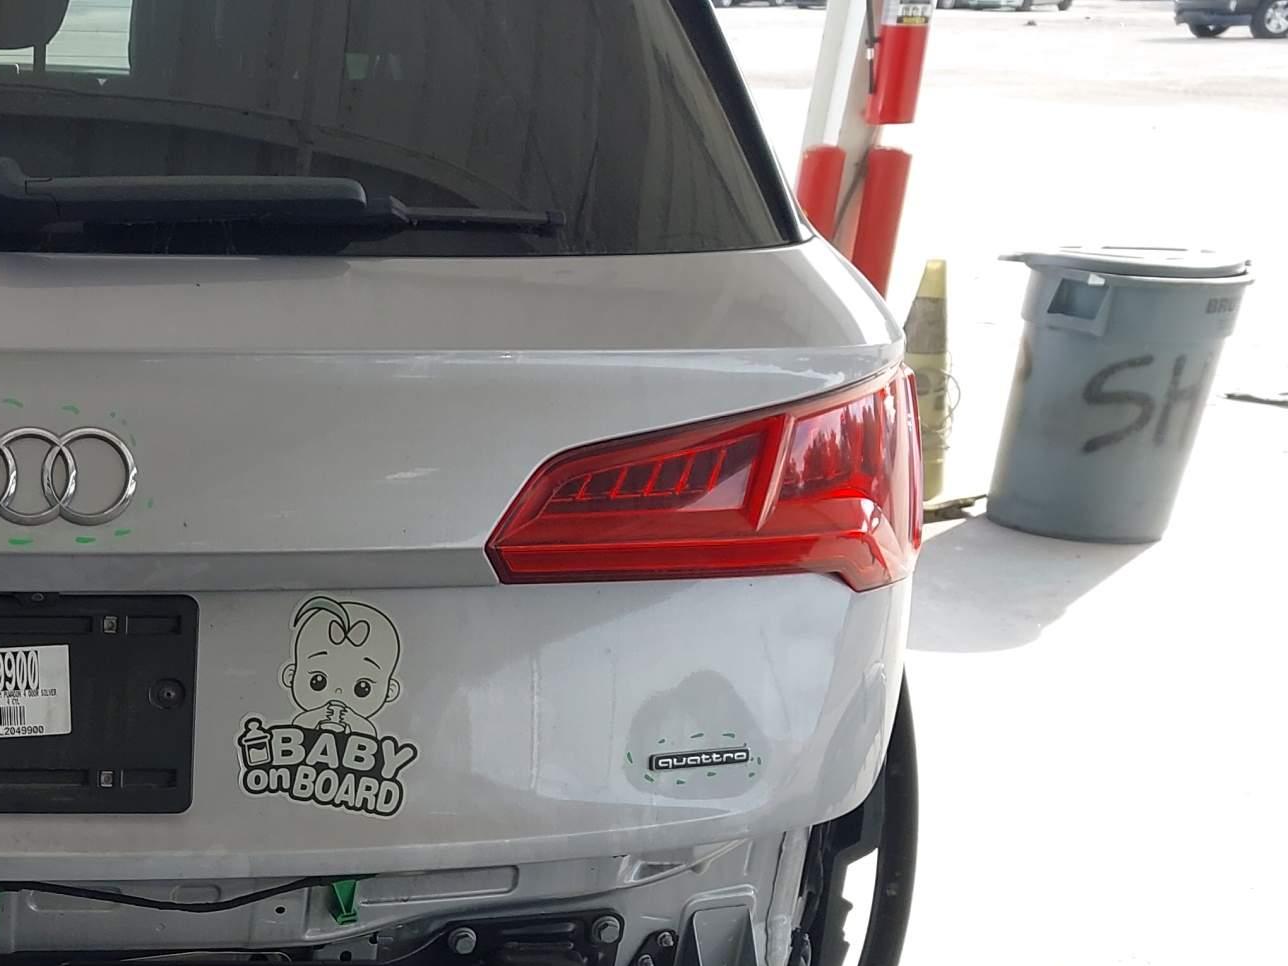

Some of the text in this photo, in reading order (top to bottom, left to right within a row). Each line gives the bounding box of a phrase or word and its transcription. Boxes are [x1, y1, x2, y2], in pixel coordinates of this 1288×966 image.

[270, 727, 415, 779] BABY
[658, 751, 747, 769] quattro
[246, 764, 400, 814] on BOARD
